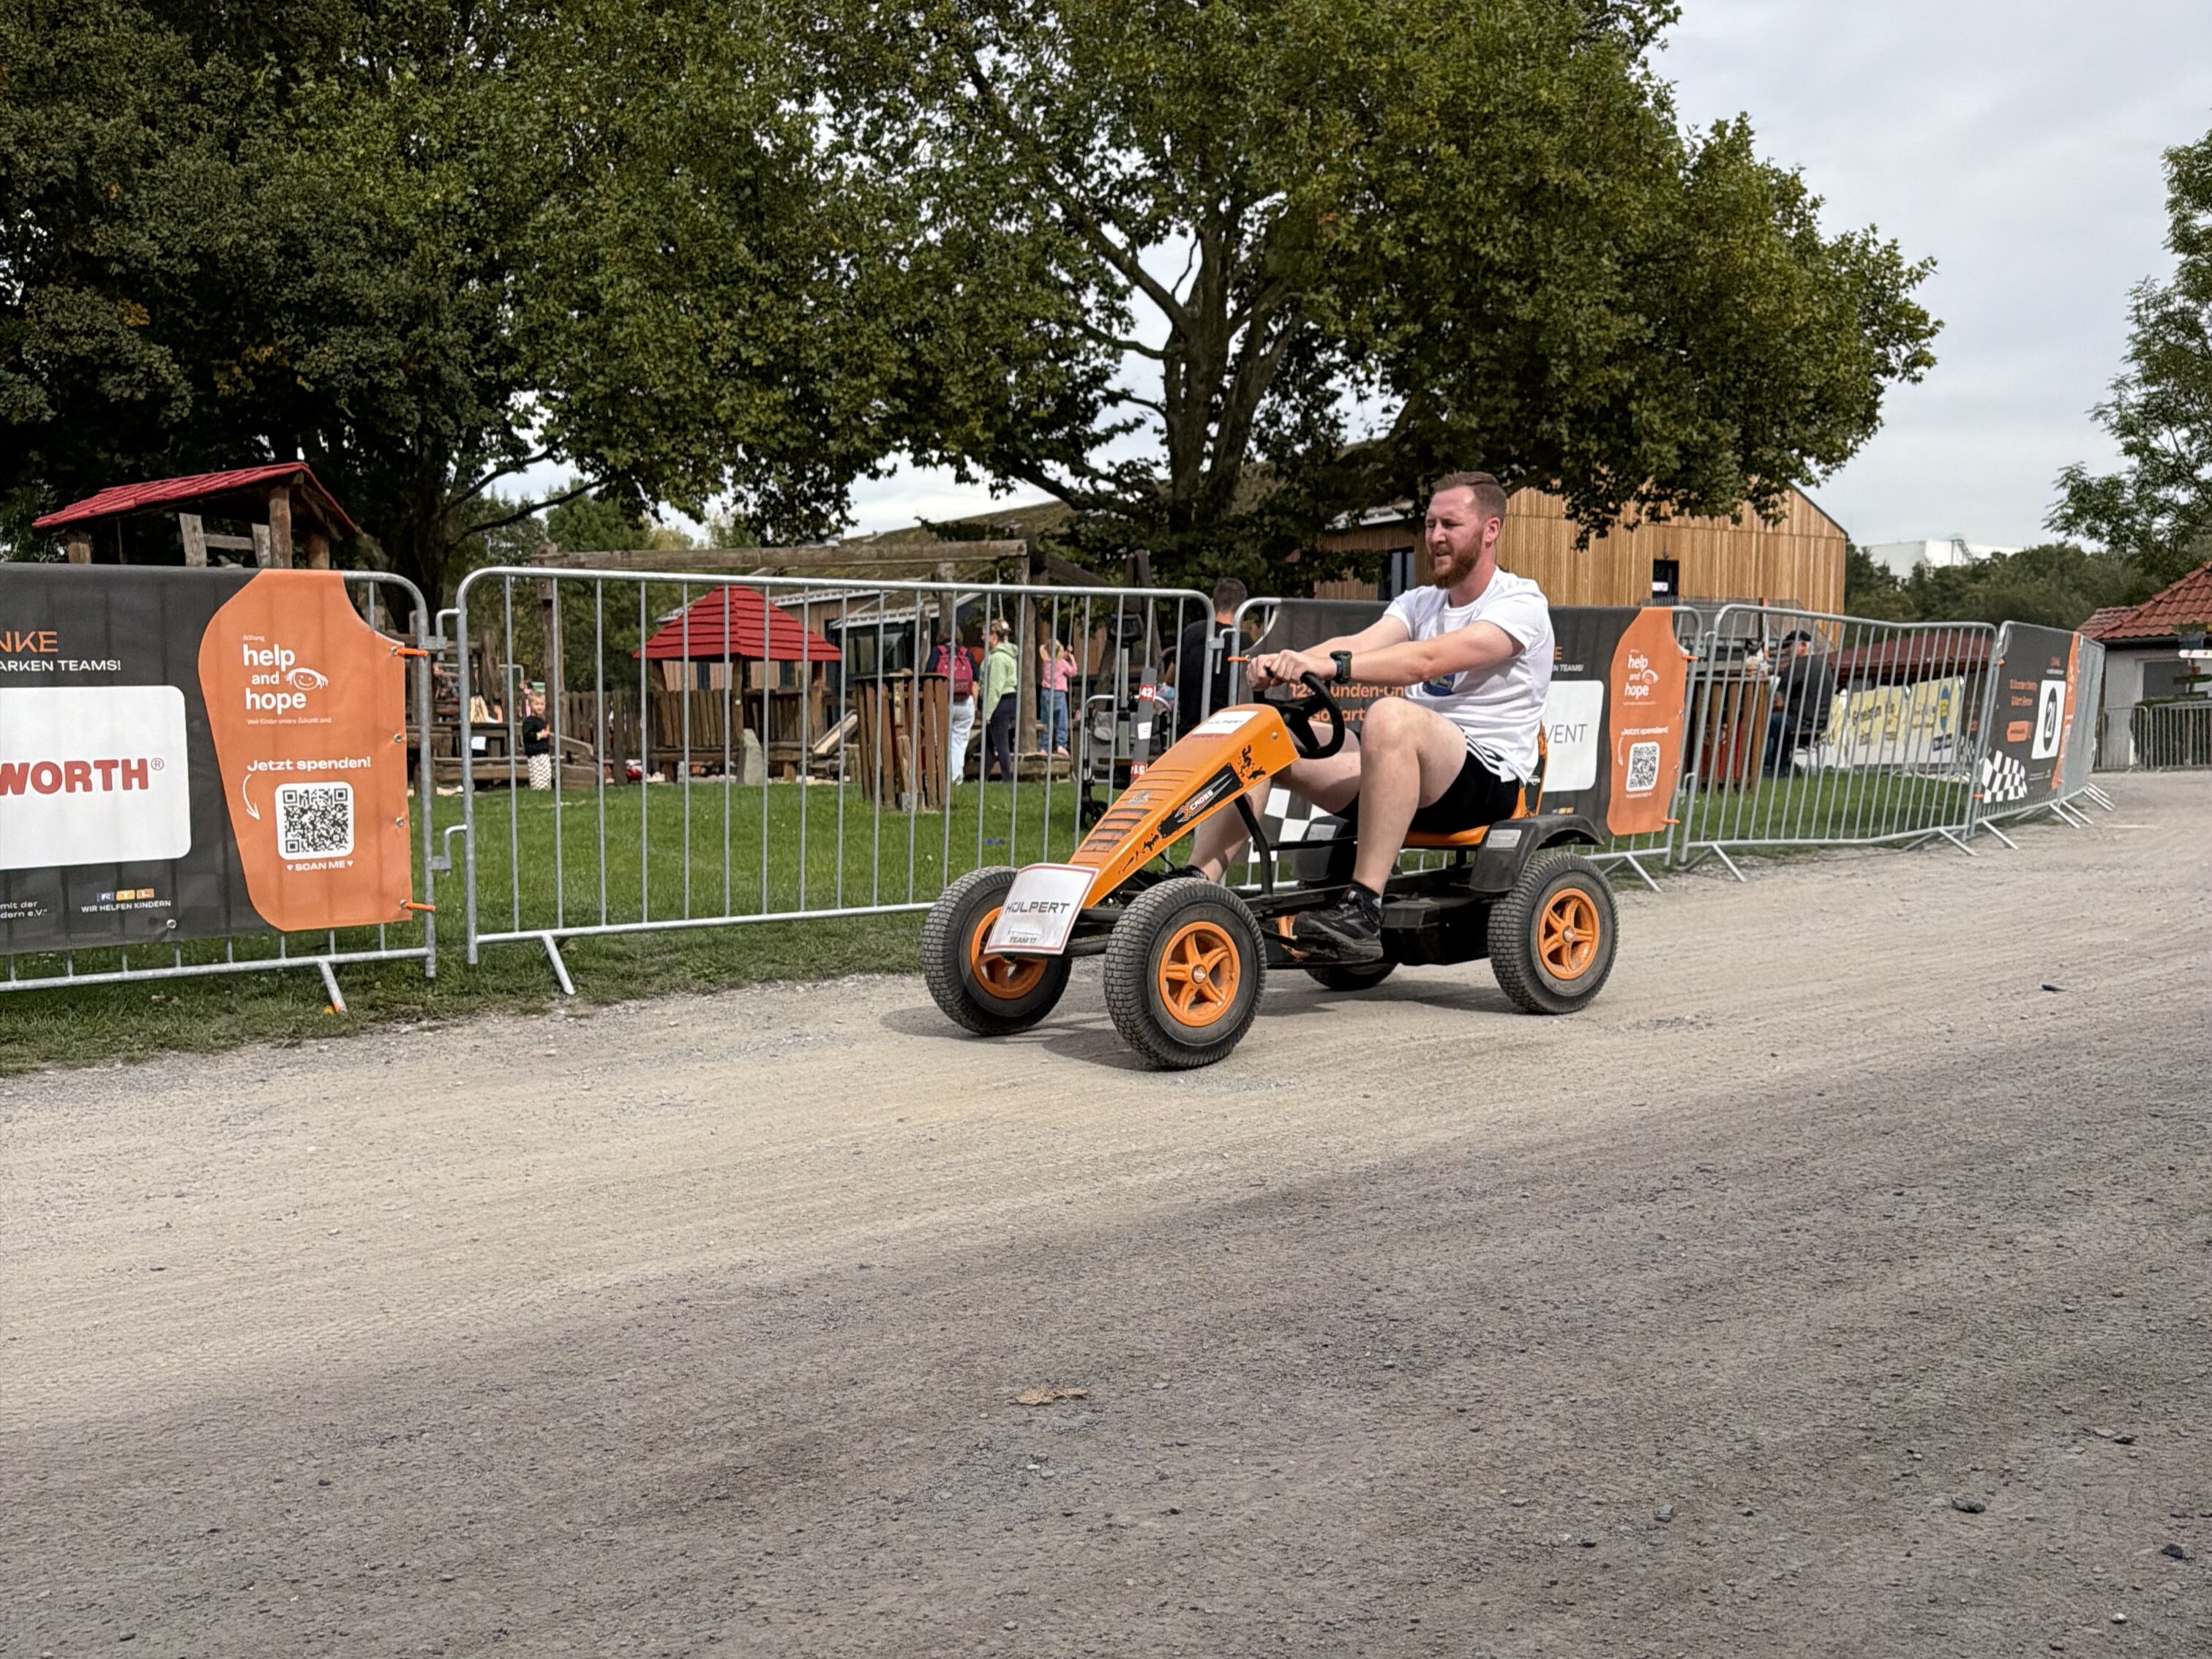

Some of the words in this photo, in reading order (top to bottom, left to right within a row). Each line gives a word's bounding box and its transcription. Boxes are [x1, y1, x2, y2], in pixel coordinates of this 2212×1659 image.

[243, 643, 296, 672] help
[1628, 654, 1649, 672] help
[57, 659, 121, 672] TEAMS!
[252, 671, 280, 685] and
[1141, 687, 1153, 697] 42
[1625, 682, 1649, 700] hope
[245, 687, 307, 715] hope
[247, 759, 294, 772] Jetzt
[296, 755, 372, 772] spenden!
[328, 860, 346, 869] ME
[81, 905, 98, 913] WIR
[99, 902, 132, 913] HELFEN
[134, 899, 171, 910] KINDERN
[1009, 936, 1030, 944] TEAM
